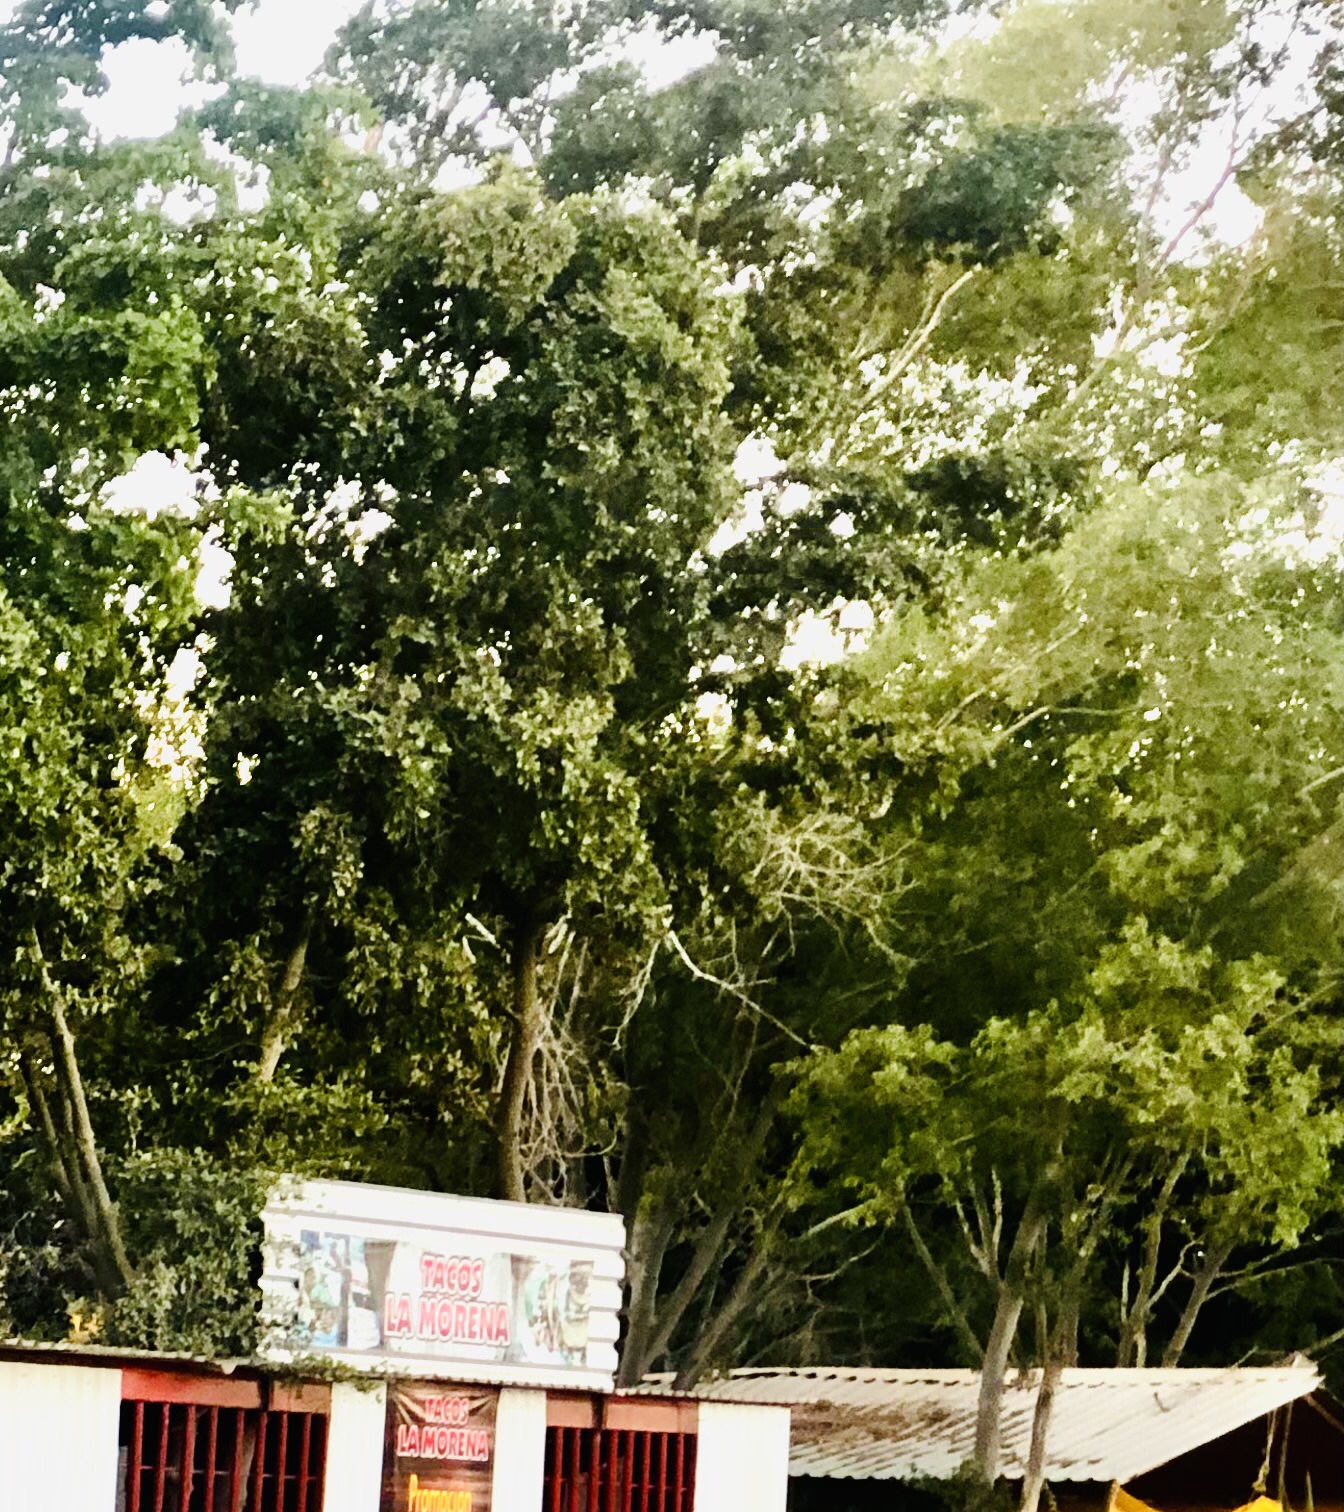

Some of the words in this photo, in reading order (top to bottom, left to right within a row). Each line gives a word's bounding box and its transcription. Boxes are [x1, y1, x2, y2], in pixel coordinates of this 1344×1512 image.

[422, 1255, 483, 1297] TACOS
[385, 1295, 413, 1337] LA
[419, 1298, 510, 1344] MORENA
[425, 1397, 470, 1424] TACOS
[397, 1424, 419, 1457] LA
[421, 1426, 489, 1462] MORENA
